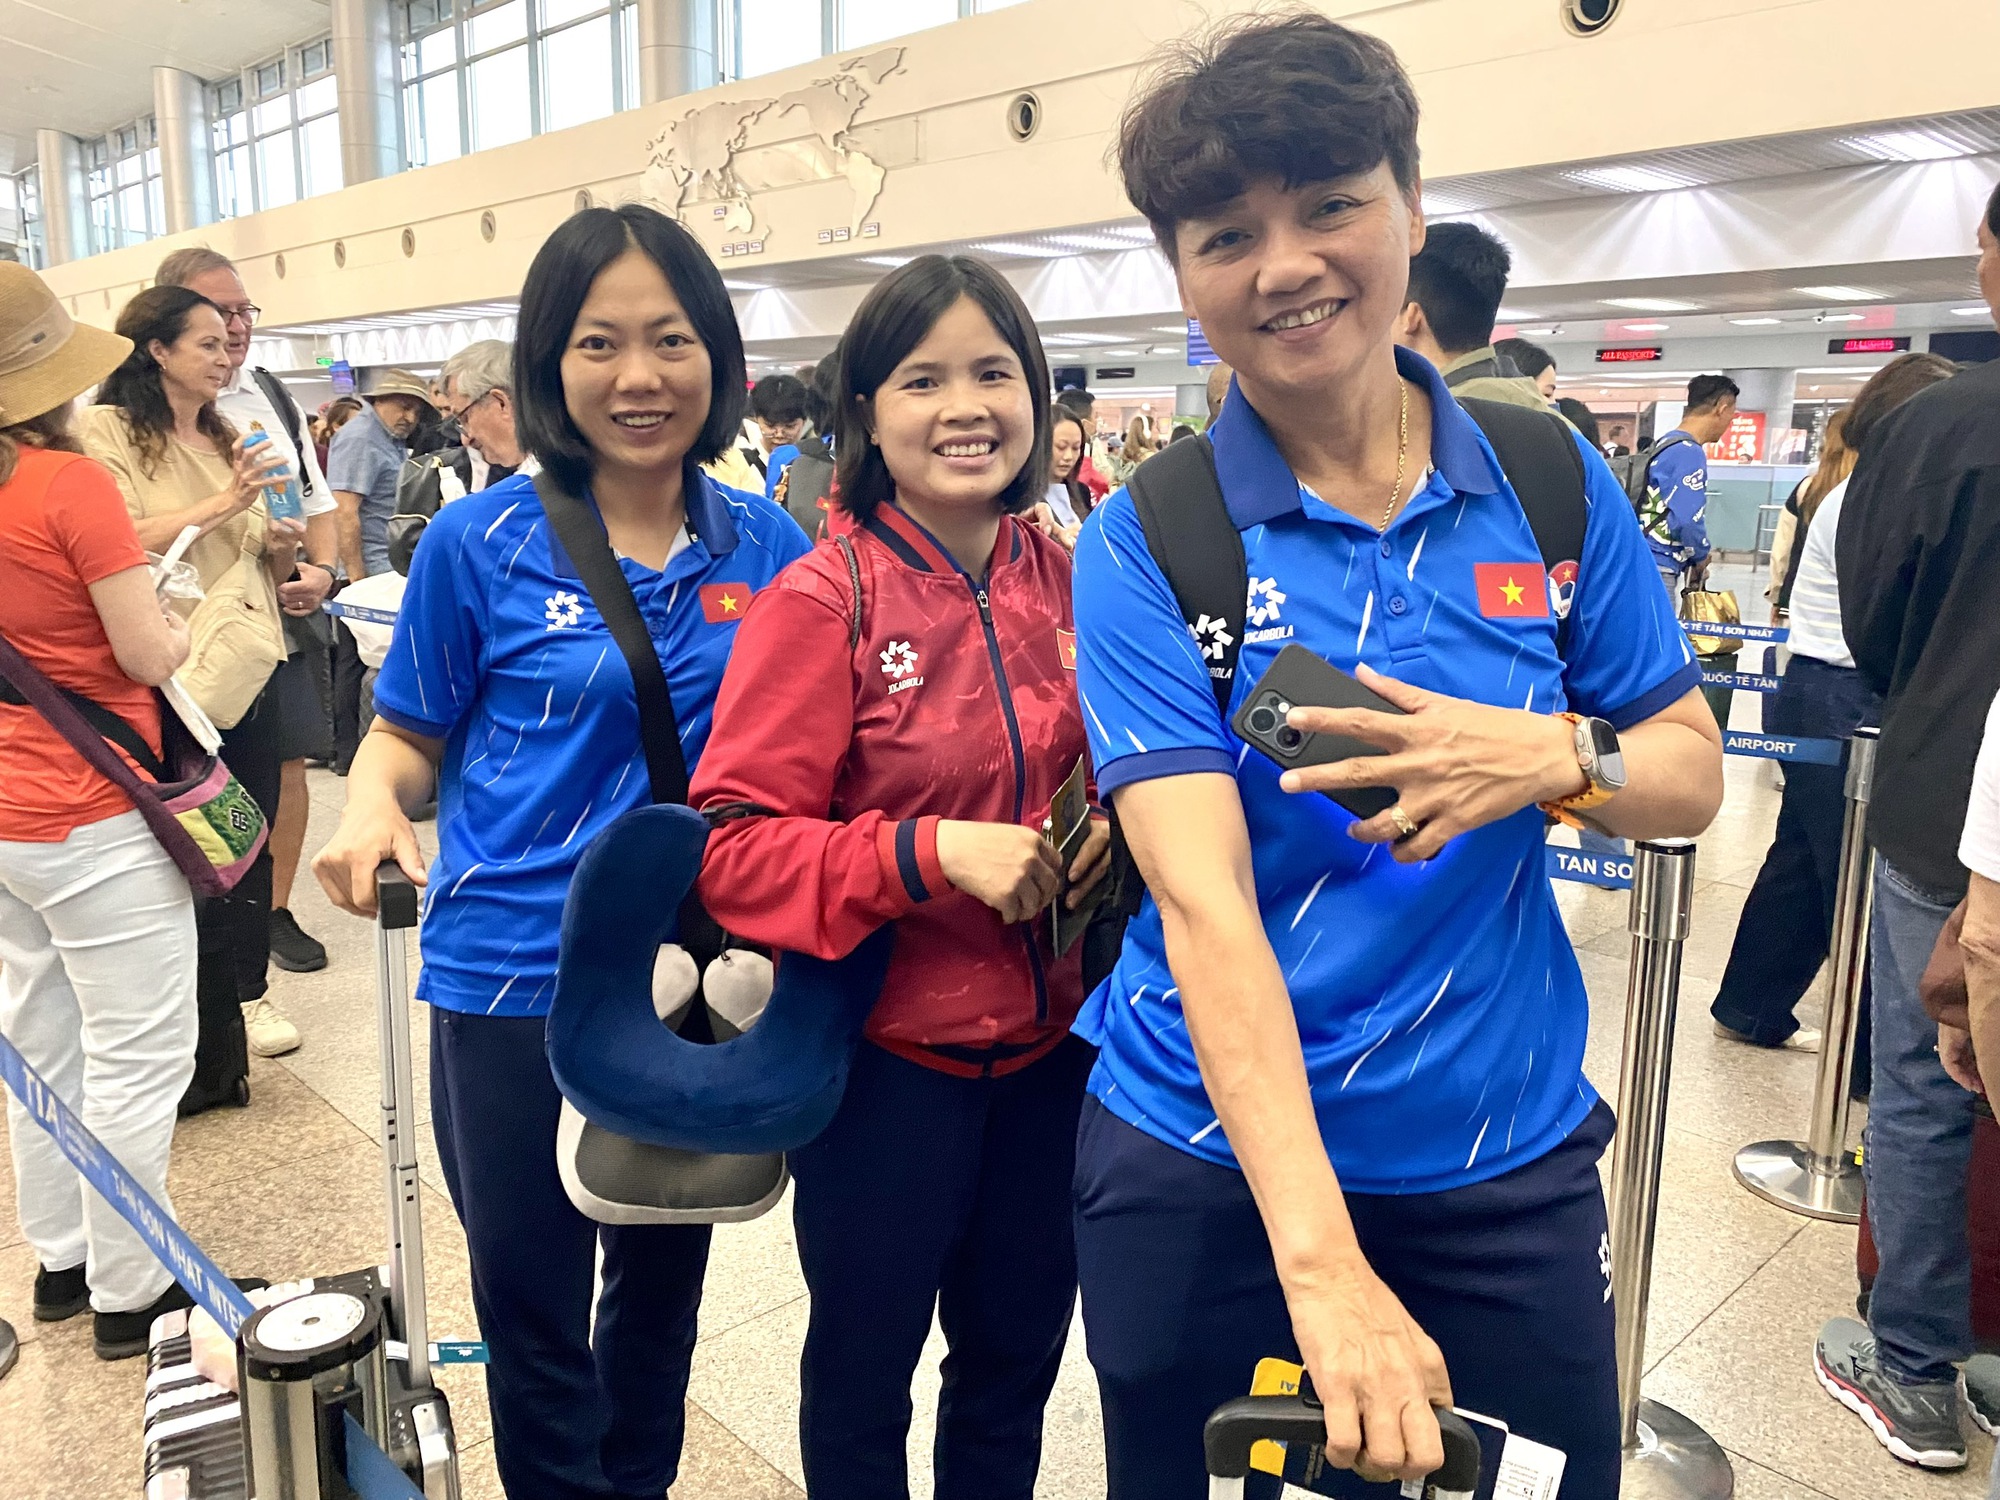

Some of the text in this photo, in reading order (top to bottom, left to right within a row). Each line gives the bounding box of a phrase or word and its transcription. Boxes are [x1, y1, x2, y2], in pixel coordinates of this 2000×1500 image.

[1601, 348, 1656, 360] ALL PASSPORTS
[1752, 676, 1778, 689] TÂN
[1726, 736, 1797, 754] AIRPORT
[1556, 853, 1633, 880] TAN SO
[22, 1064, 61, 1139] TIA
[166, 1230, 203, 1292] NHAT
[1281, 1380, 1298, 1392] AI
